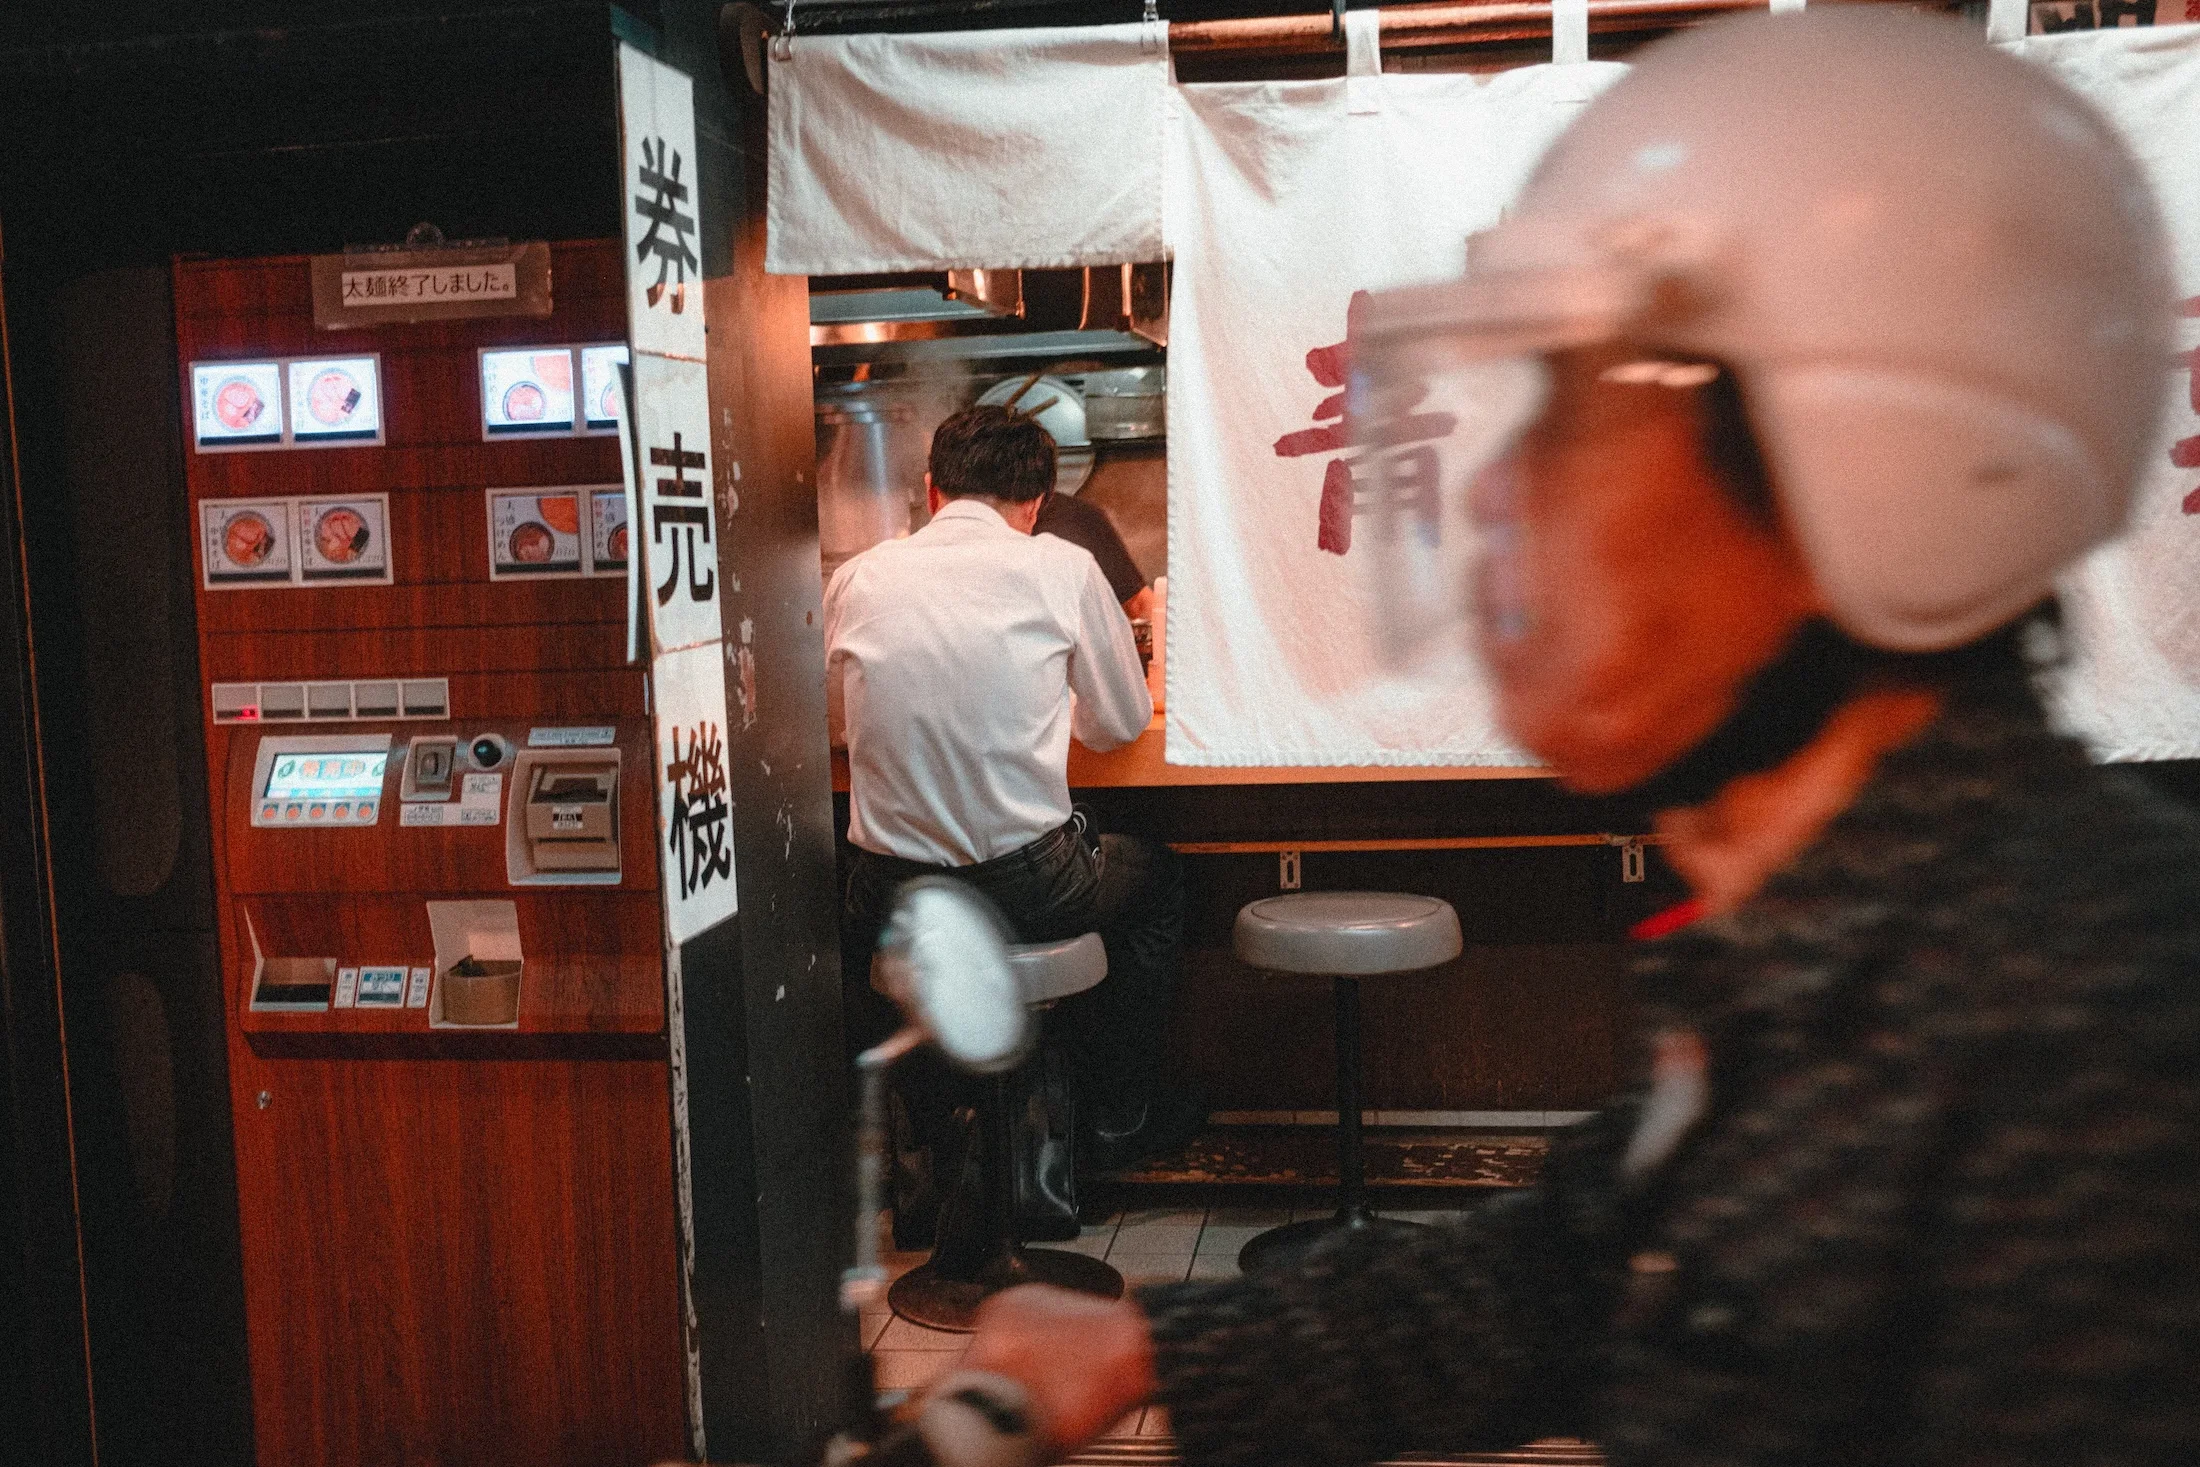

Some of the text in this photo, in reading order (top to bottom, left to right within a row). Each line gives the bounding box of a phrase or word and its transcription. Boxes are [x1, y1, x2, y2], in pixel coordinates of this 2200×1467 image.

[344, 271, 509, 299] 太麺終了しました。
[635, 136, 731, 900] 券売機
